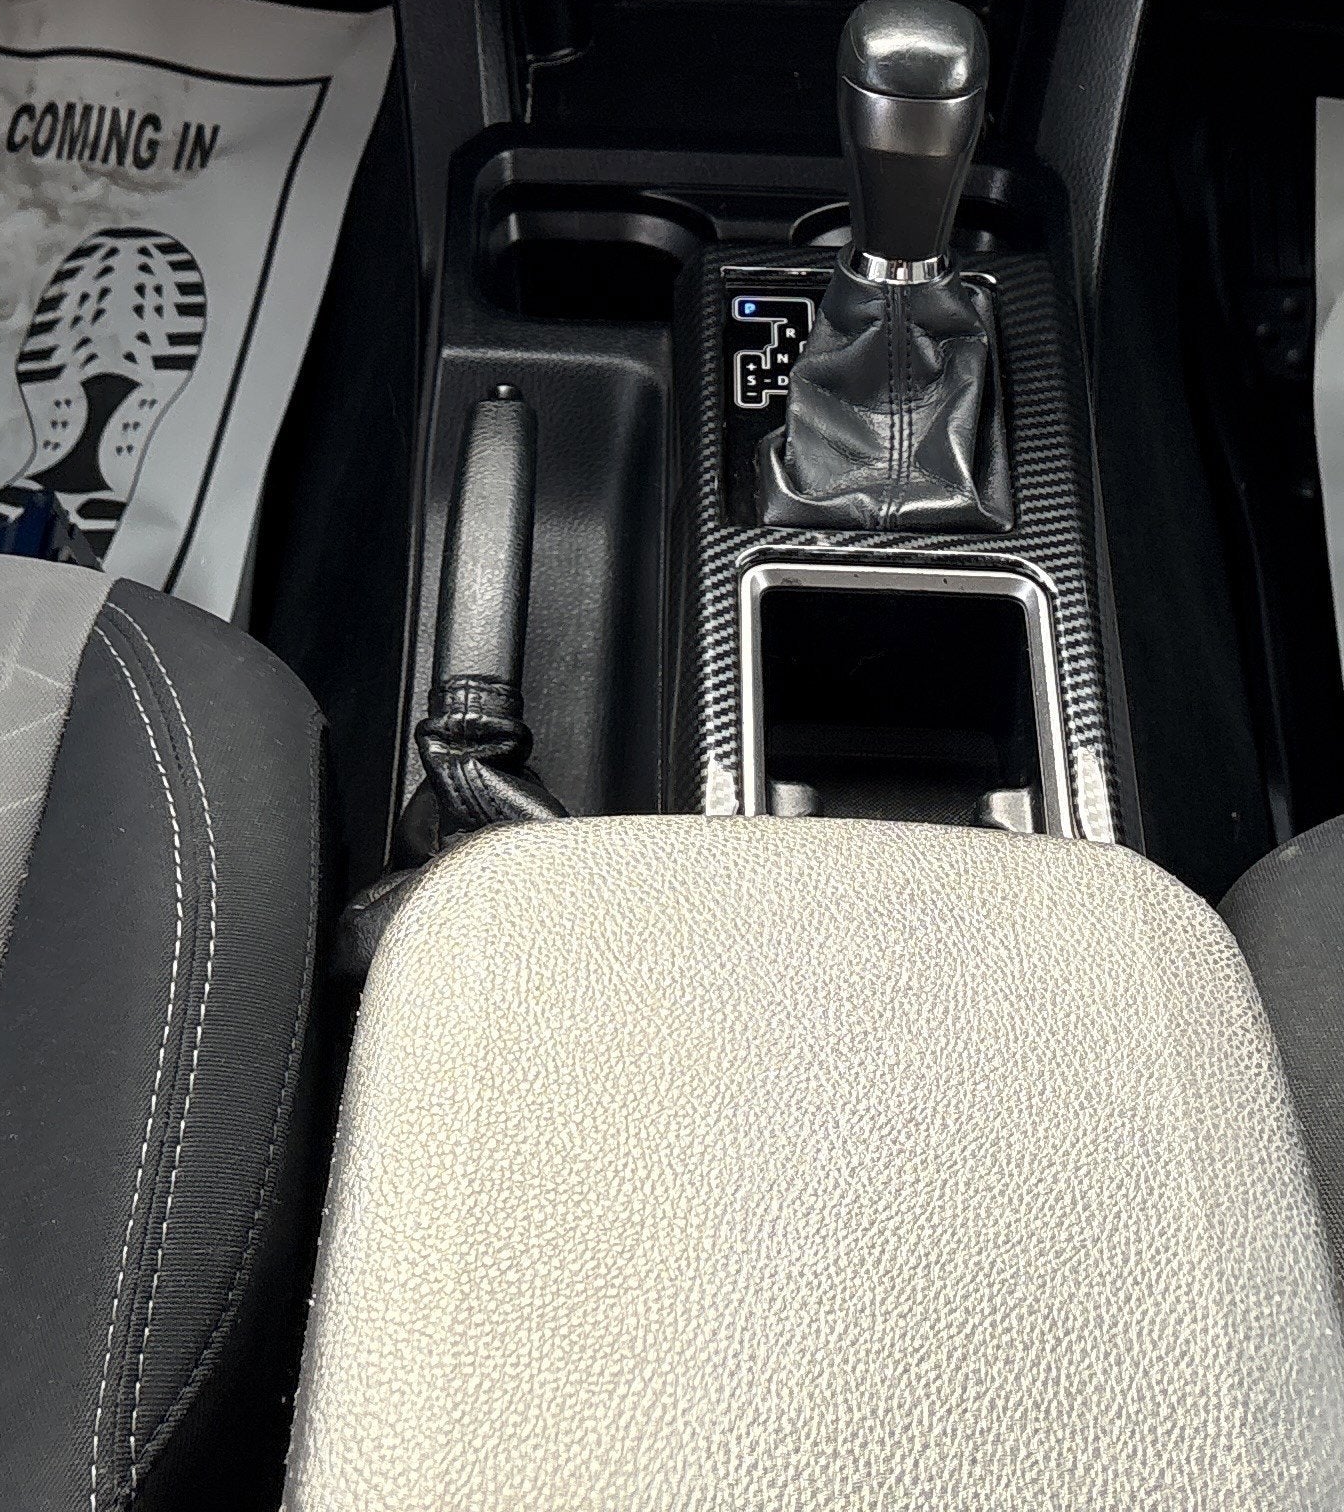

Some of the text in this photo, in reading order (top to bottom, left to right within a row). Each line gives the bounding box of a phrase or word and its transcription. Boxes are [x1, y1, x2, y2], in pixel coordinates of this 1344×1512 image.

[5, 101, 163, 172] COMING
[172, 121, 221, 172] IN
[744, 303, 756, 315] P
[785, 327, 796, 339] R
[776, 353, 789, 364] N
[777, 375, 789, 386] D
